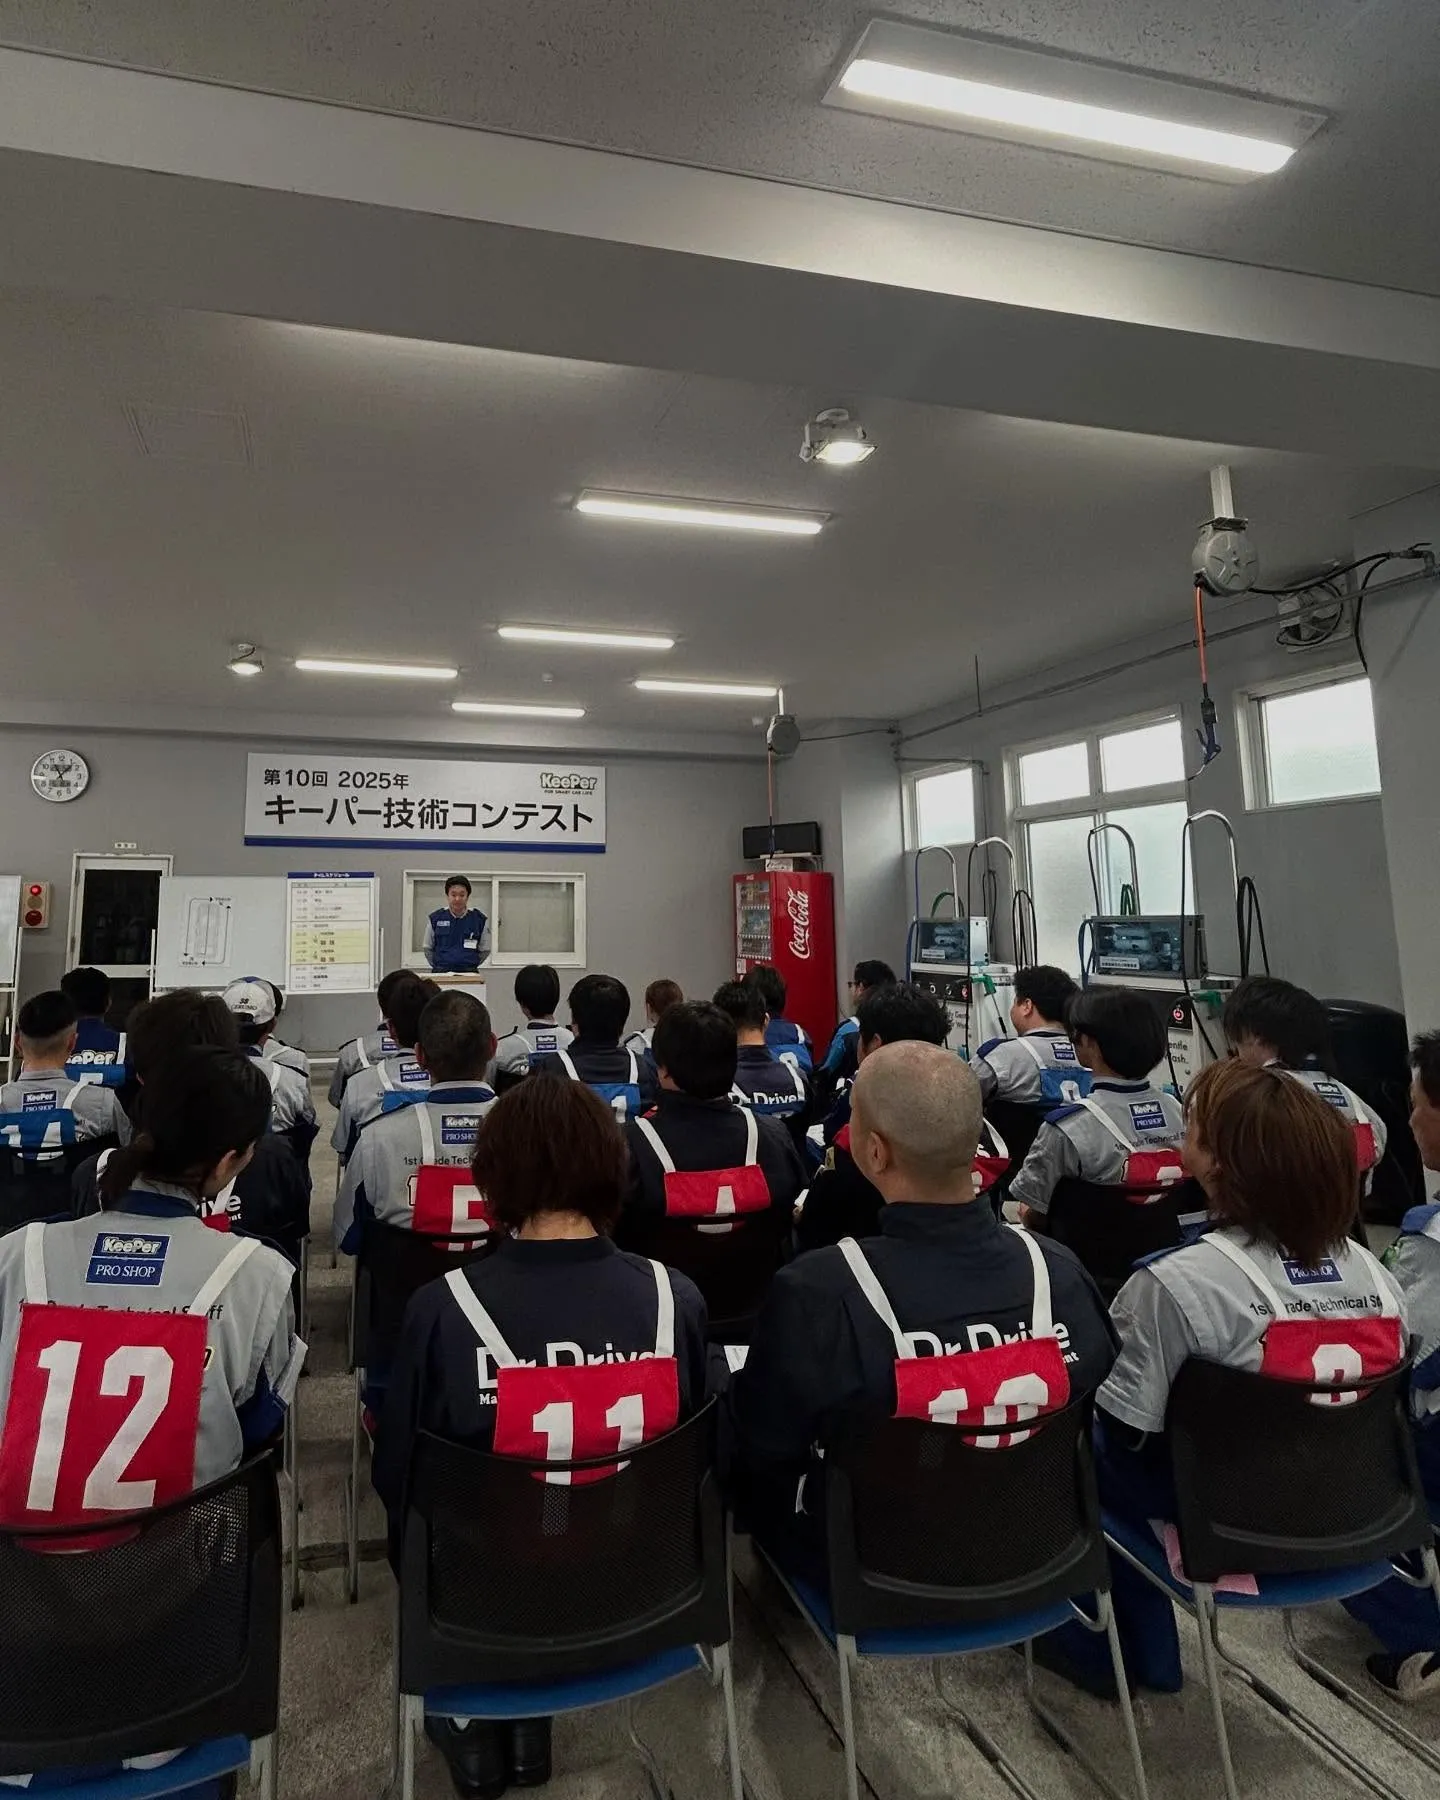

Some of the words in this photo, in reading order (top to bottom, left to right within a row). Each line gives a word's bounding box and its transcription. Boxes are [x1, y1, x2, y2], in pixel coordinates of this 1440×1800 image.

[264, 768, 328, 787] 第10回
[338, 770, 409, 790] 2025年
[540, 772, 598, 790] KeePer
[265, 795, 593, 833] キーパー技術コンテスト
[787, 886, 811, 960] Coca-Cola
[1168, 1040, 1188, 1051] entle
[26, 1092, 55, 1102] KeePer
[1132, 1103, 1159, 1115] KeePer
[460, 1132, 477, 1141] SHO
[102, 1236, 162, 1255] KeePer
[95, 1264, 121, 1276] PRO
[122, 1265, 156, 1278] SHOP
[1285, 1300, 1312, 1314] rade
[1312, 1295, 1368, 1313] Technical
[27, 1339, 174, 1512] 12
[533, 1393, 644, 1486] 11
